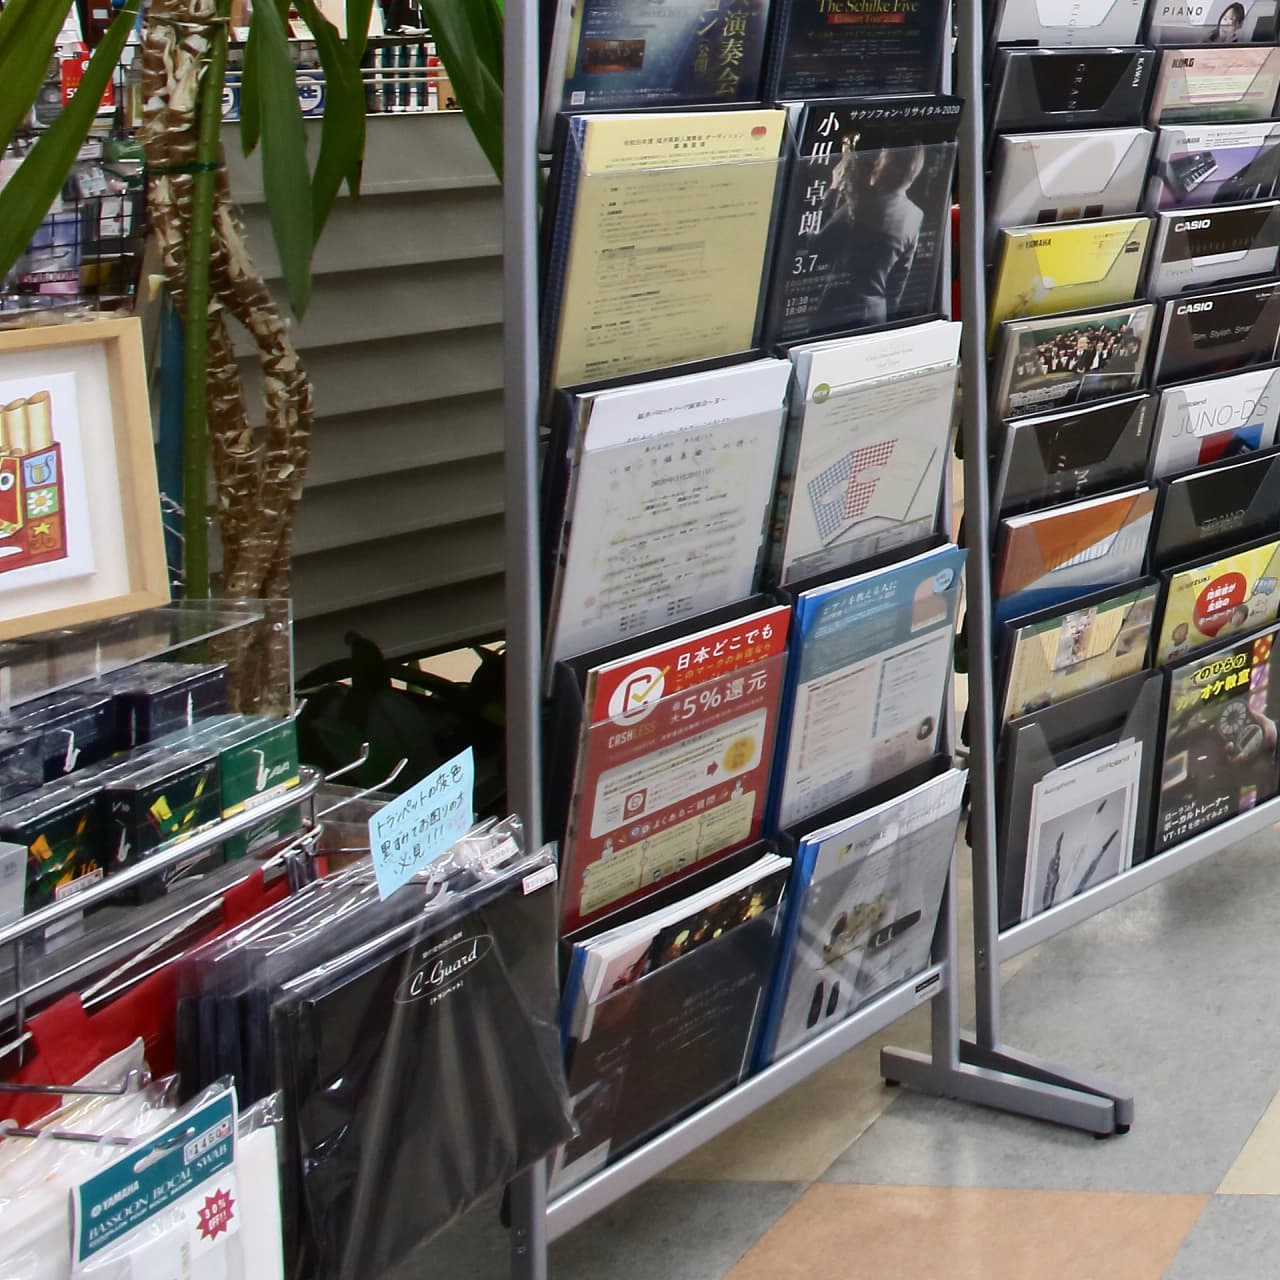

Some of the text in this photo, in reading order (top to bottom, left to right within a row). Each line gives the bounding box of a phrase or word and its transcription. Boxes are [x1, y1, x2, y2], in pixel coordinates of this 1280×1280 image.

[1162, 6, 1203, 17] PIANO
[797, 111, 840, 237] 小川 卓朗
[1175, 219, 1211, 232] CASIO
[792, 254, 818, 274] 3.7
[1177, 301, 1213, 315] CASIO
[1172, 396, 1270, 438] JUNO-DS
[676, 623, 773, 671] 日本どこでも
[410, 937, 478, 997] C-Guard
[101, 1180, 140, 1211] YAMAHA
[88, 1194, 149, 1242] BASSOON
